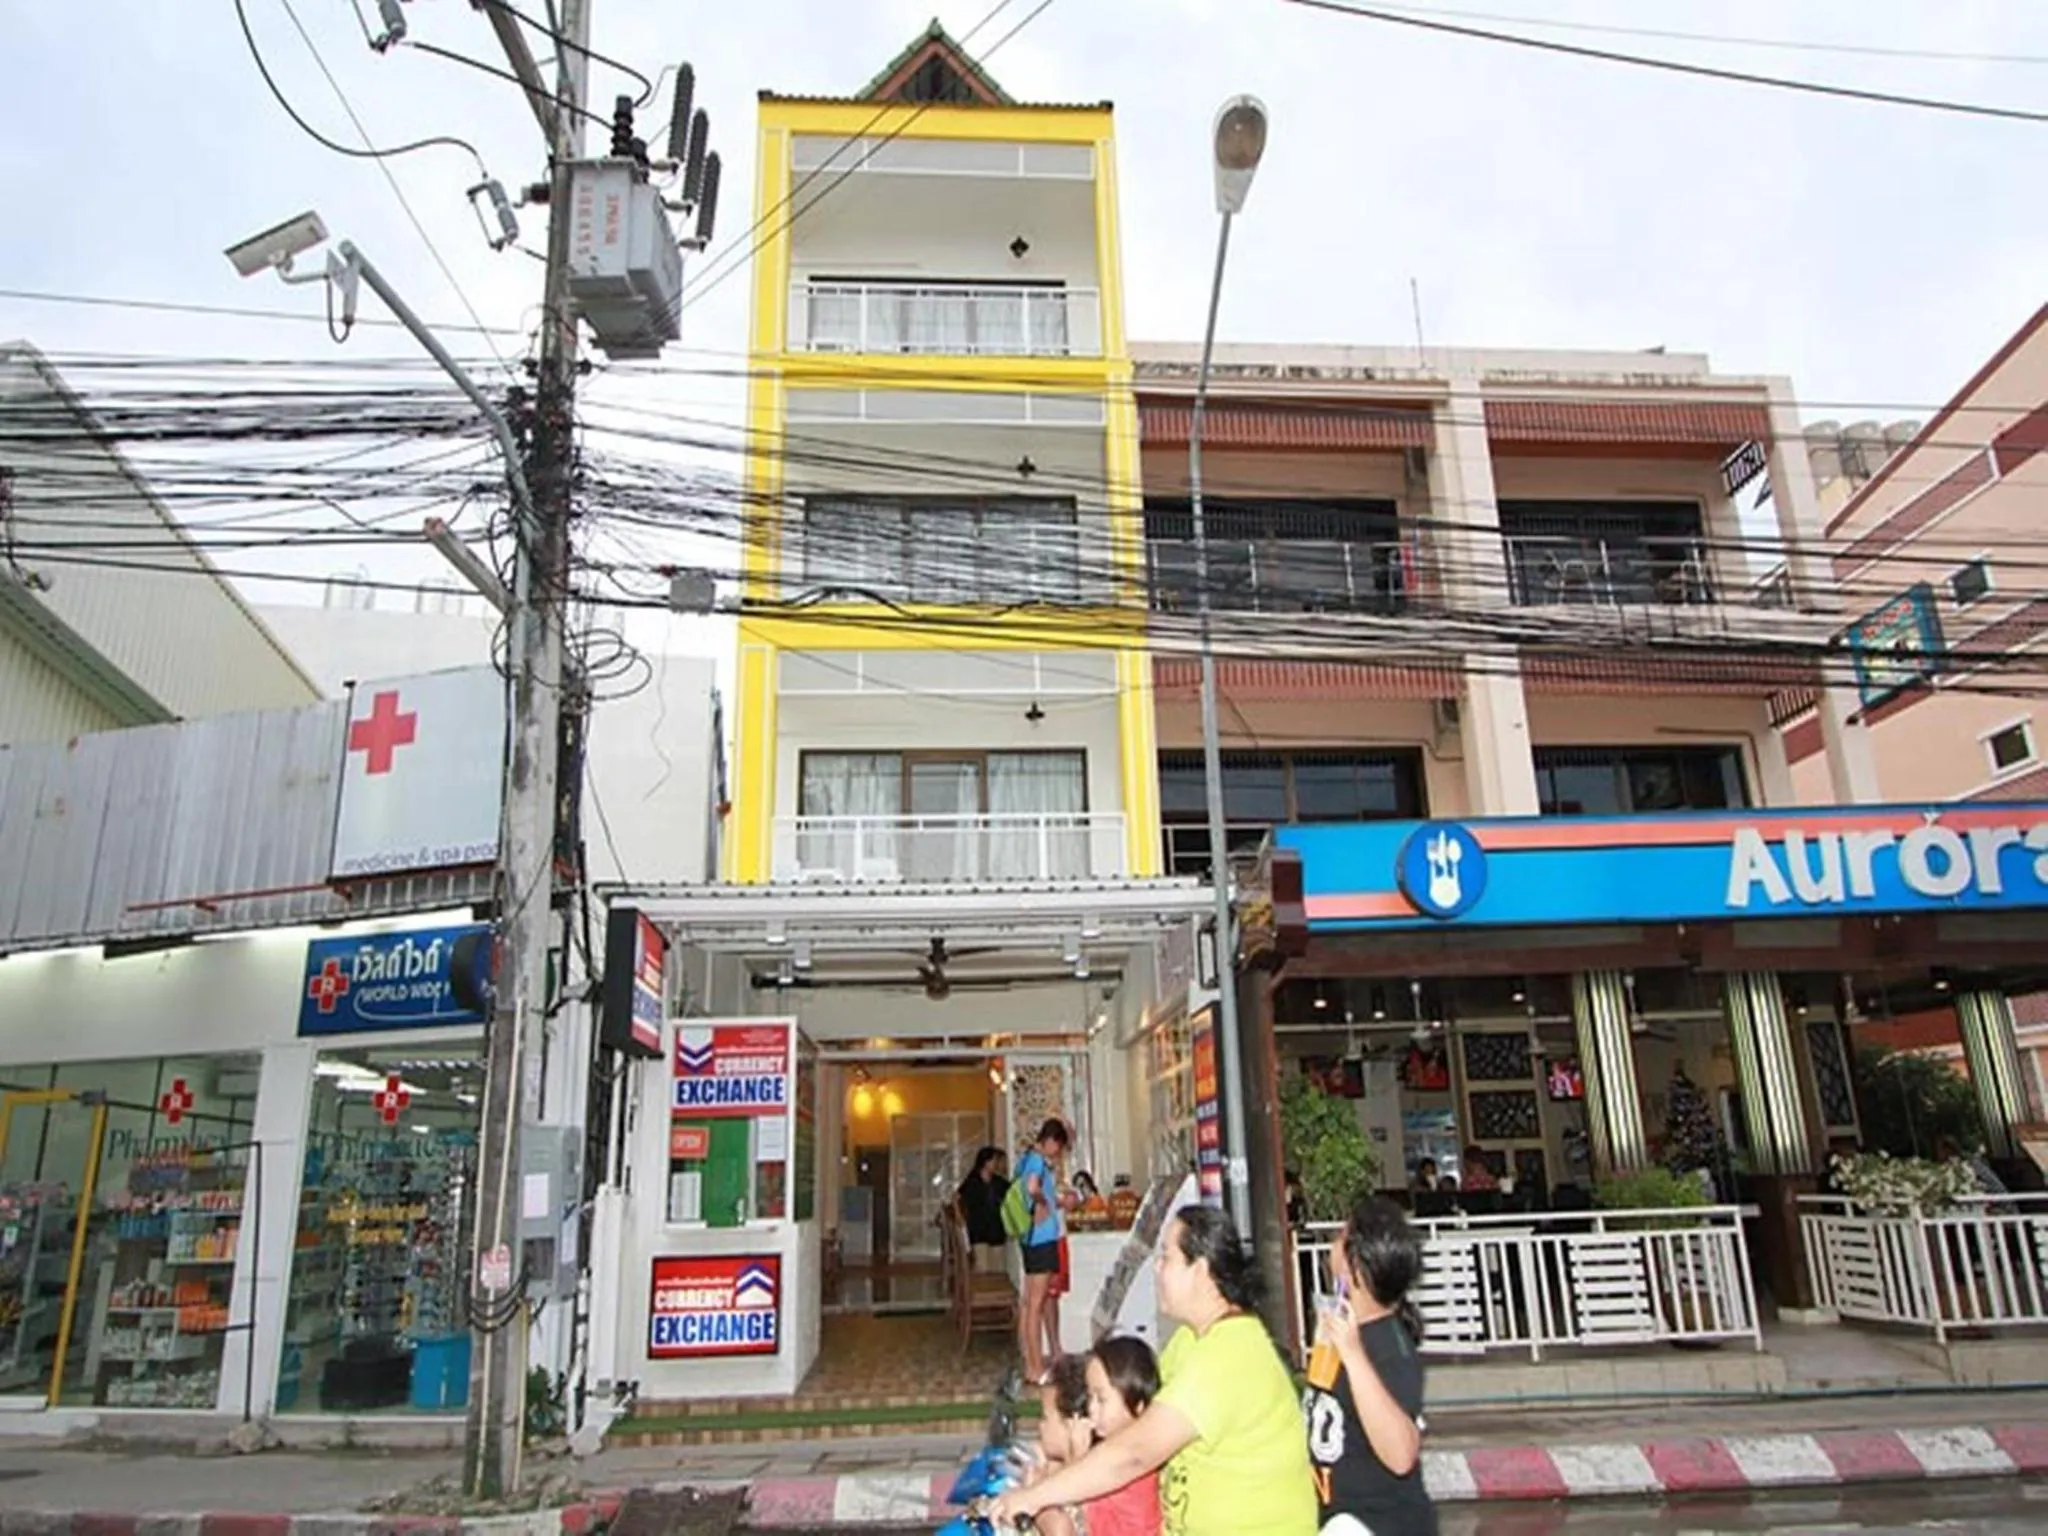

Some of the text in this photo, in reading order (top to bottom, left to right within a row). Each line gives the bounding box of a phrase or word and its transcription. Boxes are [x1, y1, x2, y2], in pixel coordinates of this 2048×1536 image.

[418, 846, 430, 866] &
[433, 847, 461, 866] spa
[361, 983, 409, 1002] WORLD
[410, 980, 442, 999] WIDE
[714, 1056, 785, 1075] CURRENCY
[677, 1077, 784, 1104] EXCHANGE
[655, 1287, 735, 1310] CURRENCY
[655, 1312, 775, 1345] EXCHANGE
